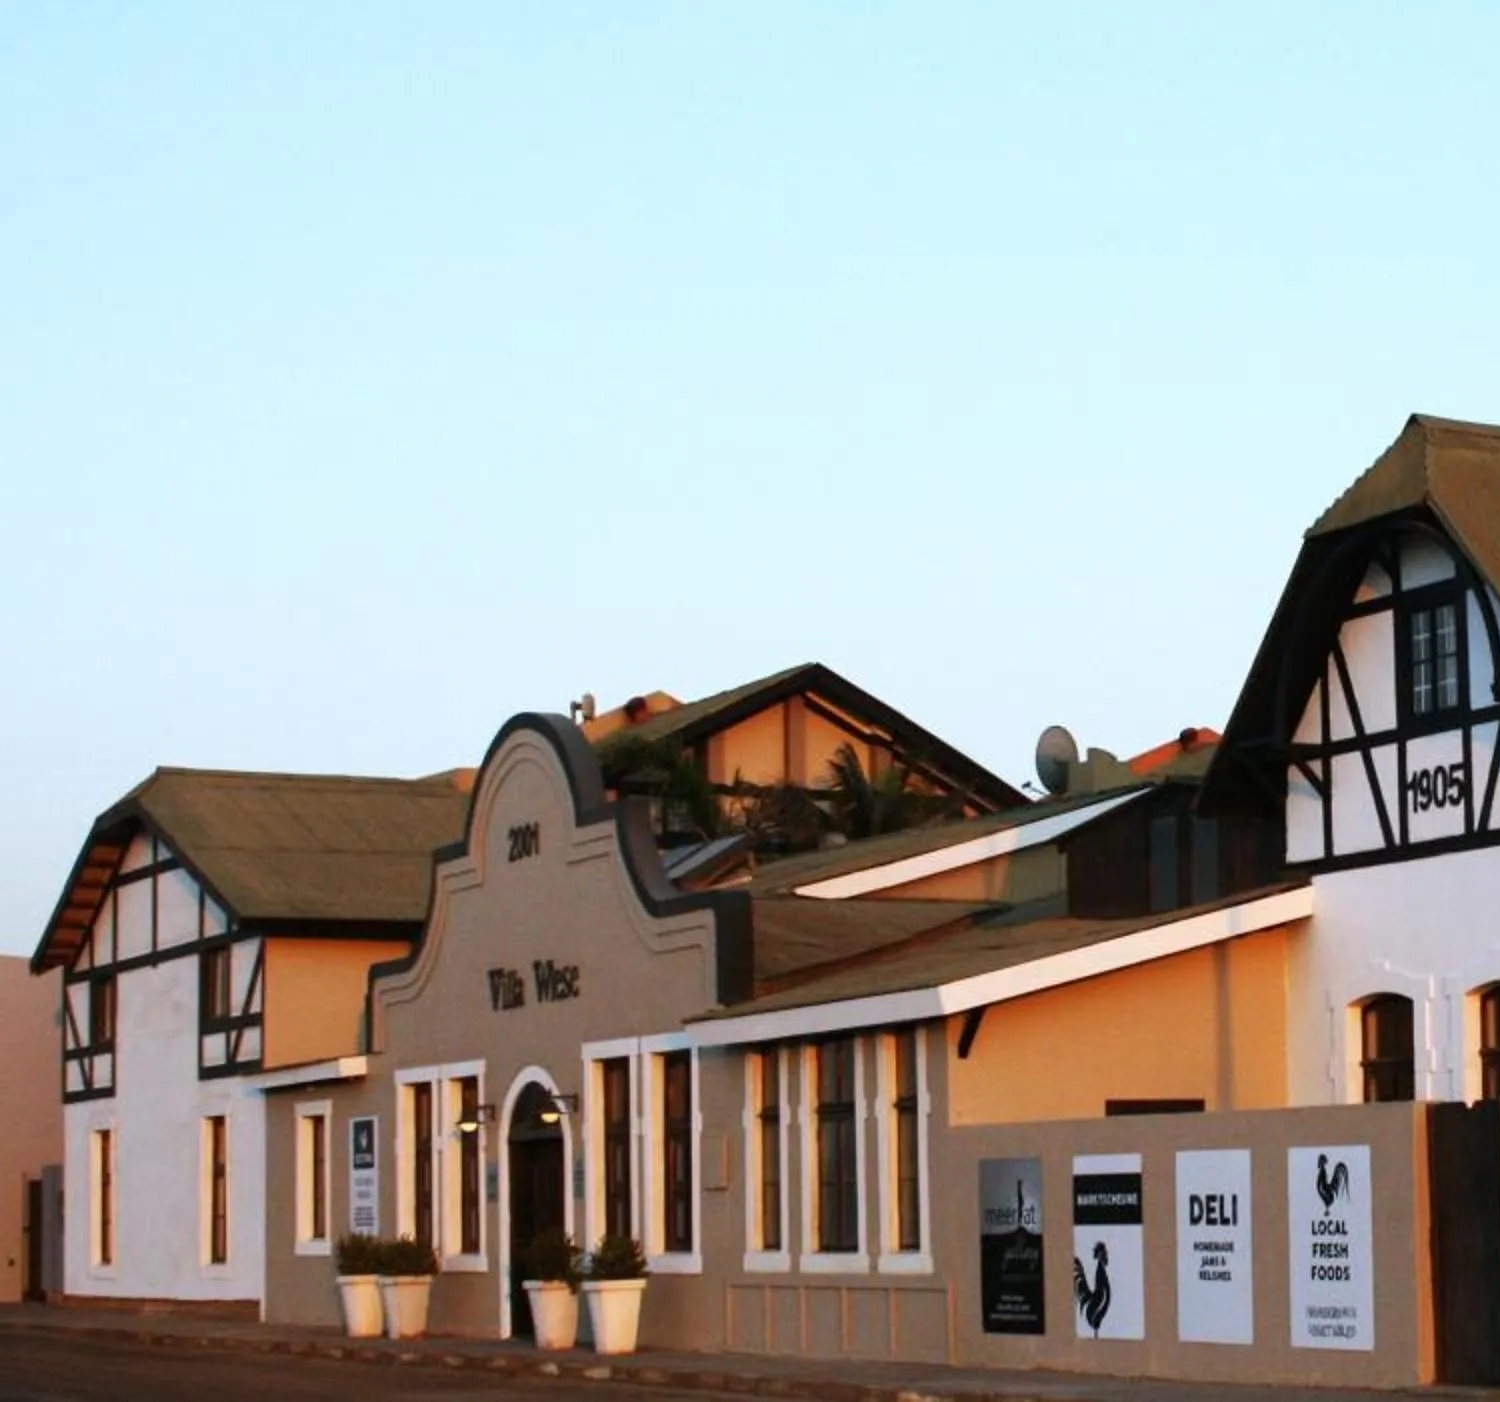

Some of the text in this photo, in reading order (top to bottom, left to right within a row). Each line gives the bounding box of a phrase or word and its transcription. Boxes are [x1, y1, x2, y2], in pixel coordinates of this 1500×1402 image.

[1406, 762, 1465, 814] 1905
[507, 821, 540, 863] 2001
[487, 959, 580, 1012] Villa Wiese
[984, 1203, 1036, 1226] meerat
[1189, 1194, 1238, 1227] DELI
[1311, 1220, 1348, 1236] LOCAL
[1193, 1241, 1234, 1252] HOMEMADE
[1312, 1243, 1349, 1259] FRESH
[1201, 1255, 1219, 1268] JAMS
[1311, 1266, 1351, 1281] FOODS
